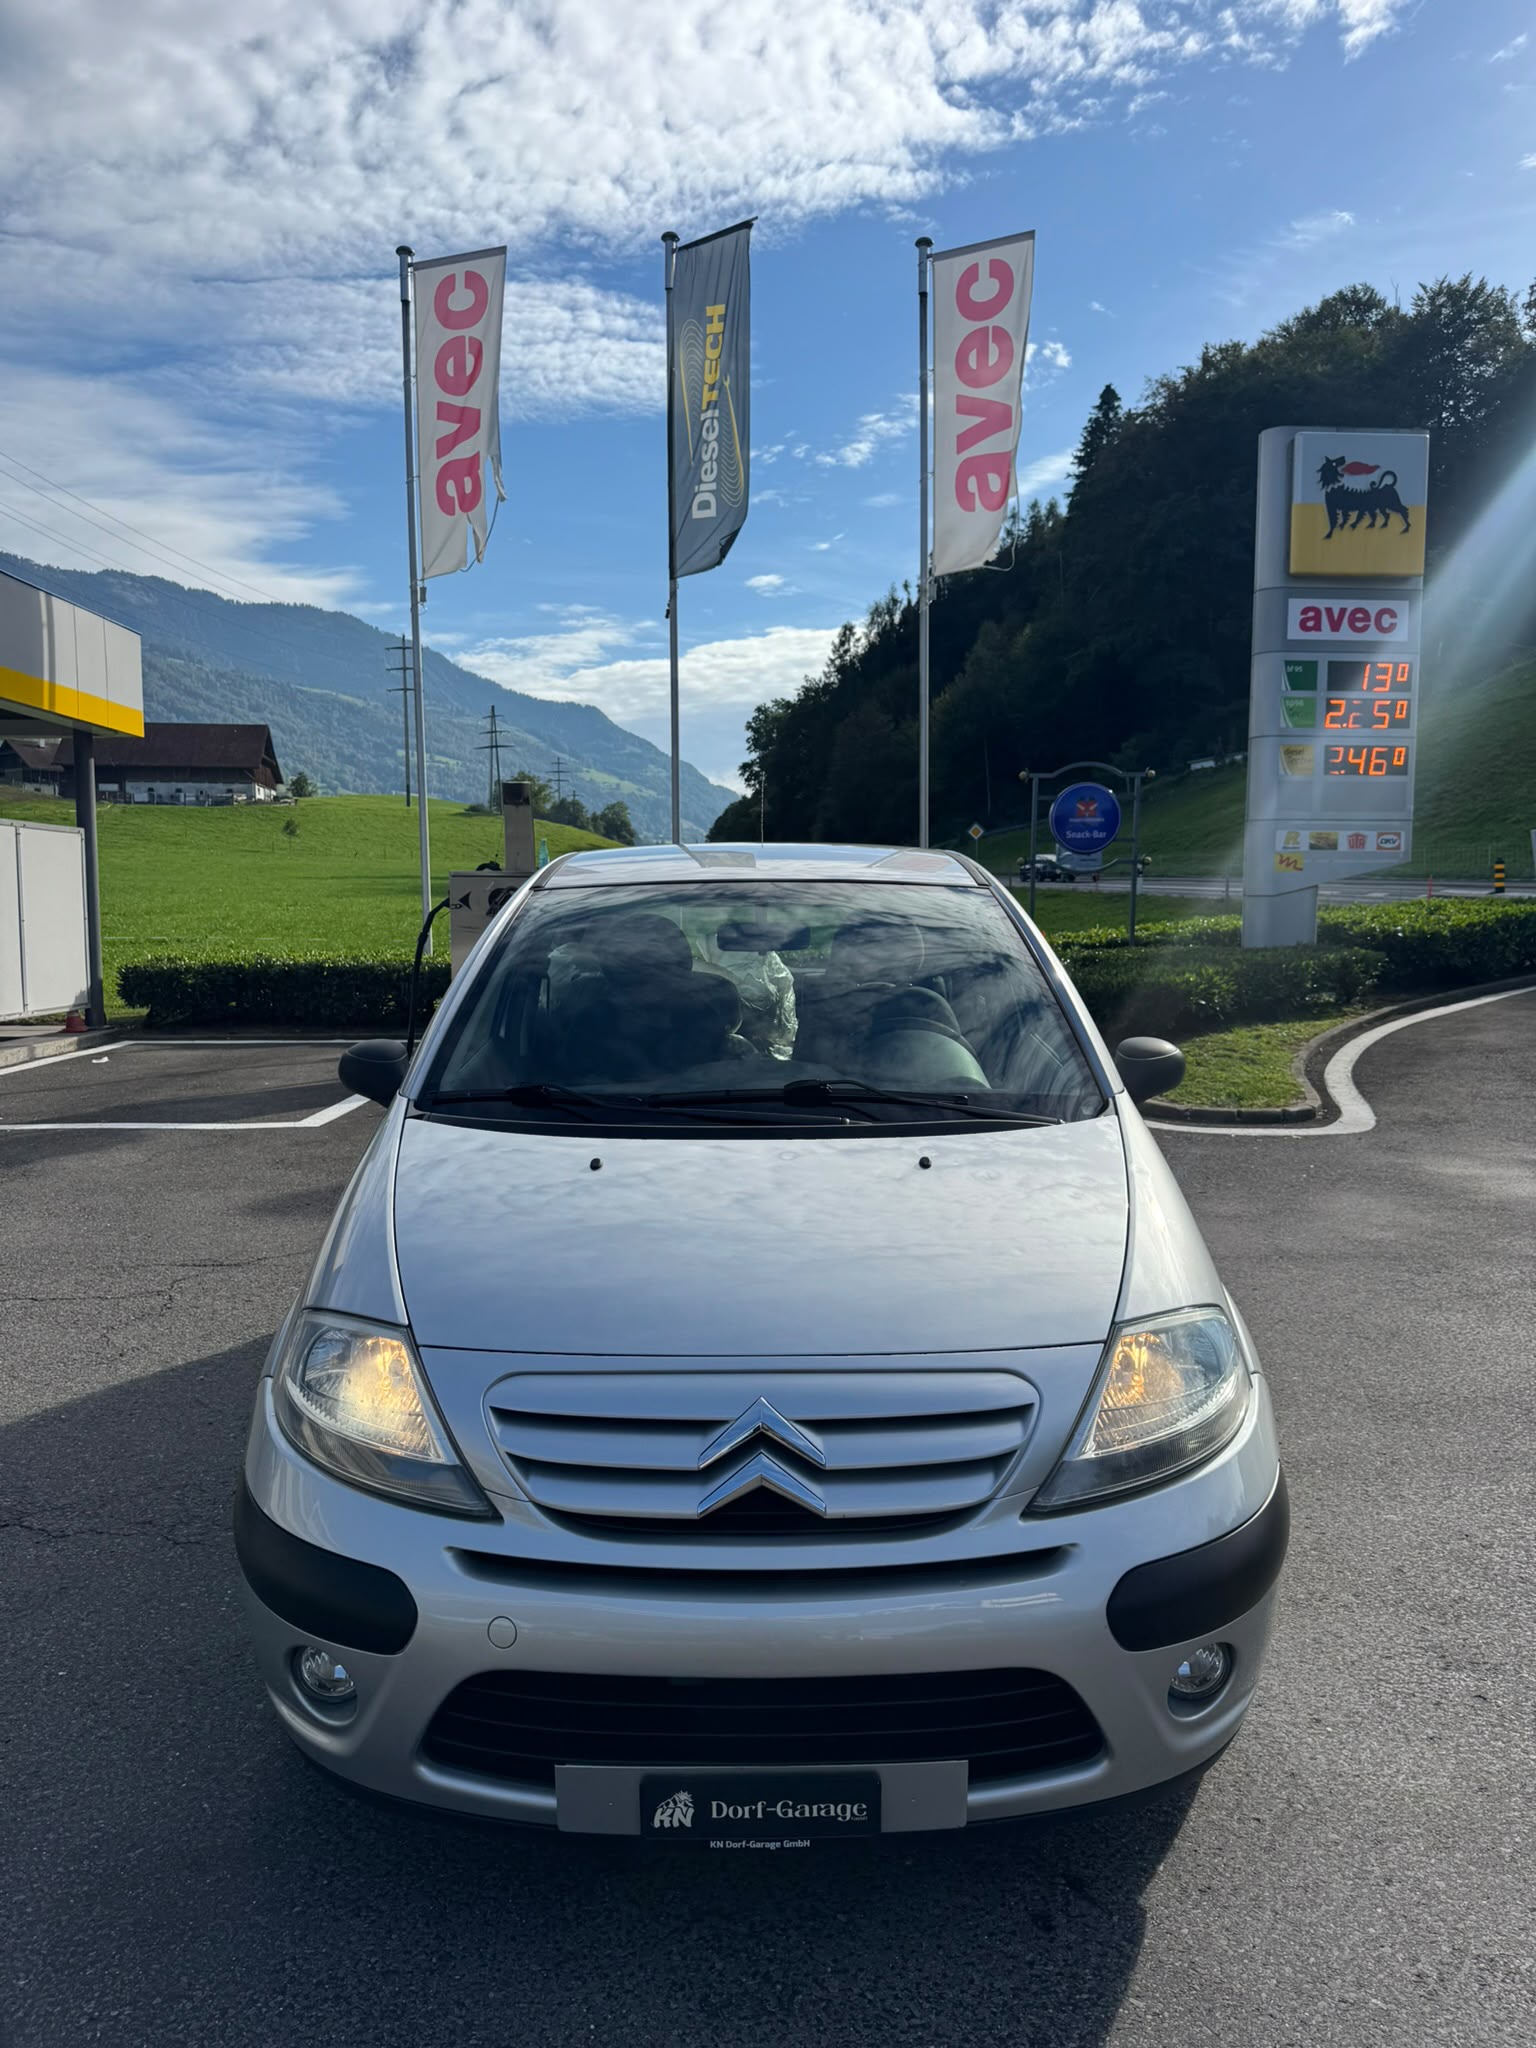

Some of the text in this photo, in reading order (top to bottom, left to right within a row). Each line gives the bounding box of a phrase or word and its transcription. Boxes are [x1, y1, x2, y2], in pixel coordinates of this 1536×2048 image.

[434, 270, 489, 517] avec
[955, 258, 1015, 513] avec
[1298, 605, 1398, 634] avec
[711, 1800, 868, 1822] Dorf-Garage
[725, 1840, 781, 1850] Dorf-Garage
[783, 1840, 811, 1848] GmbH
